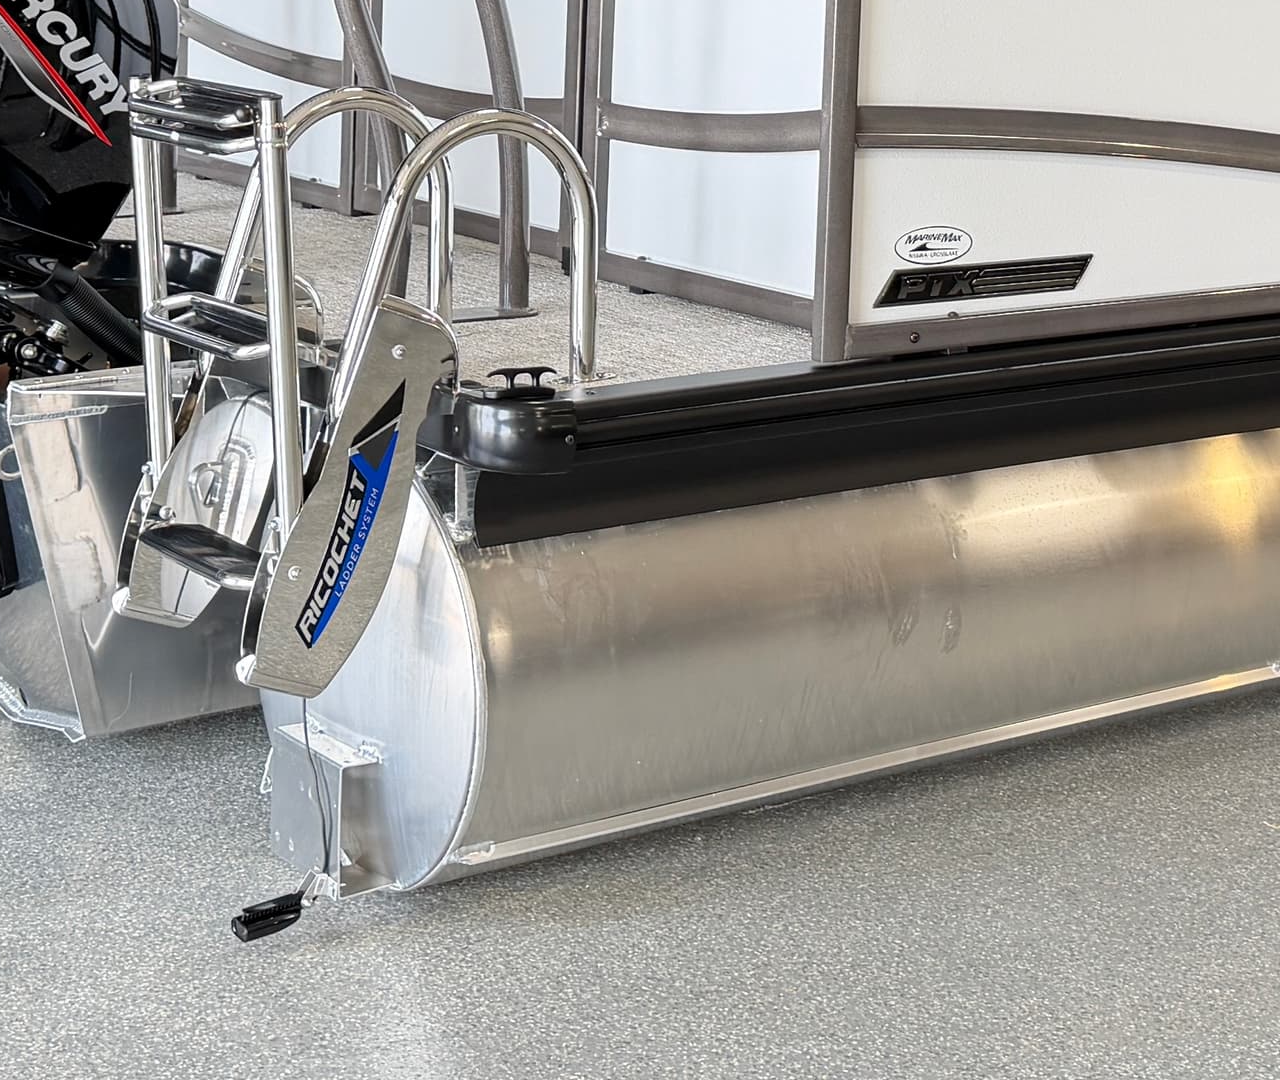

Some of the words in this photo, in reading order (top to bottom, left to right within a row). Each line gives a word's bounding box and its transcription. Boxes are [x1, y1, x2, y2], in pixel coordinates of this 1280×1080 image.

[897, 270, 980, 300] PTX
[299, 469, 366, 643] RICOCHET
[335, 543, 361, 597] LADDER
[358, 488, 379, 540] SYSTEM
